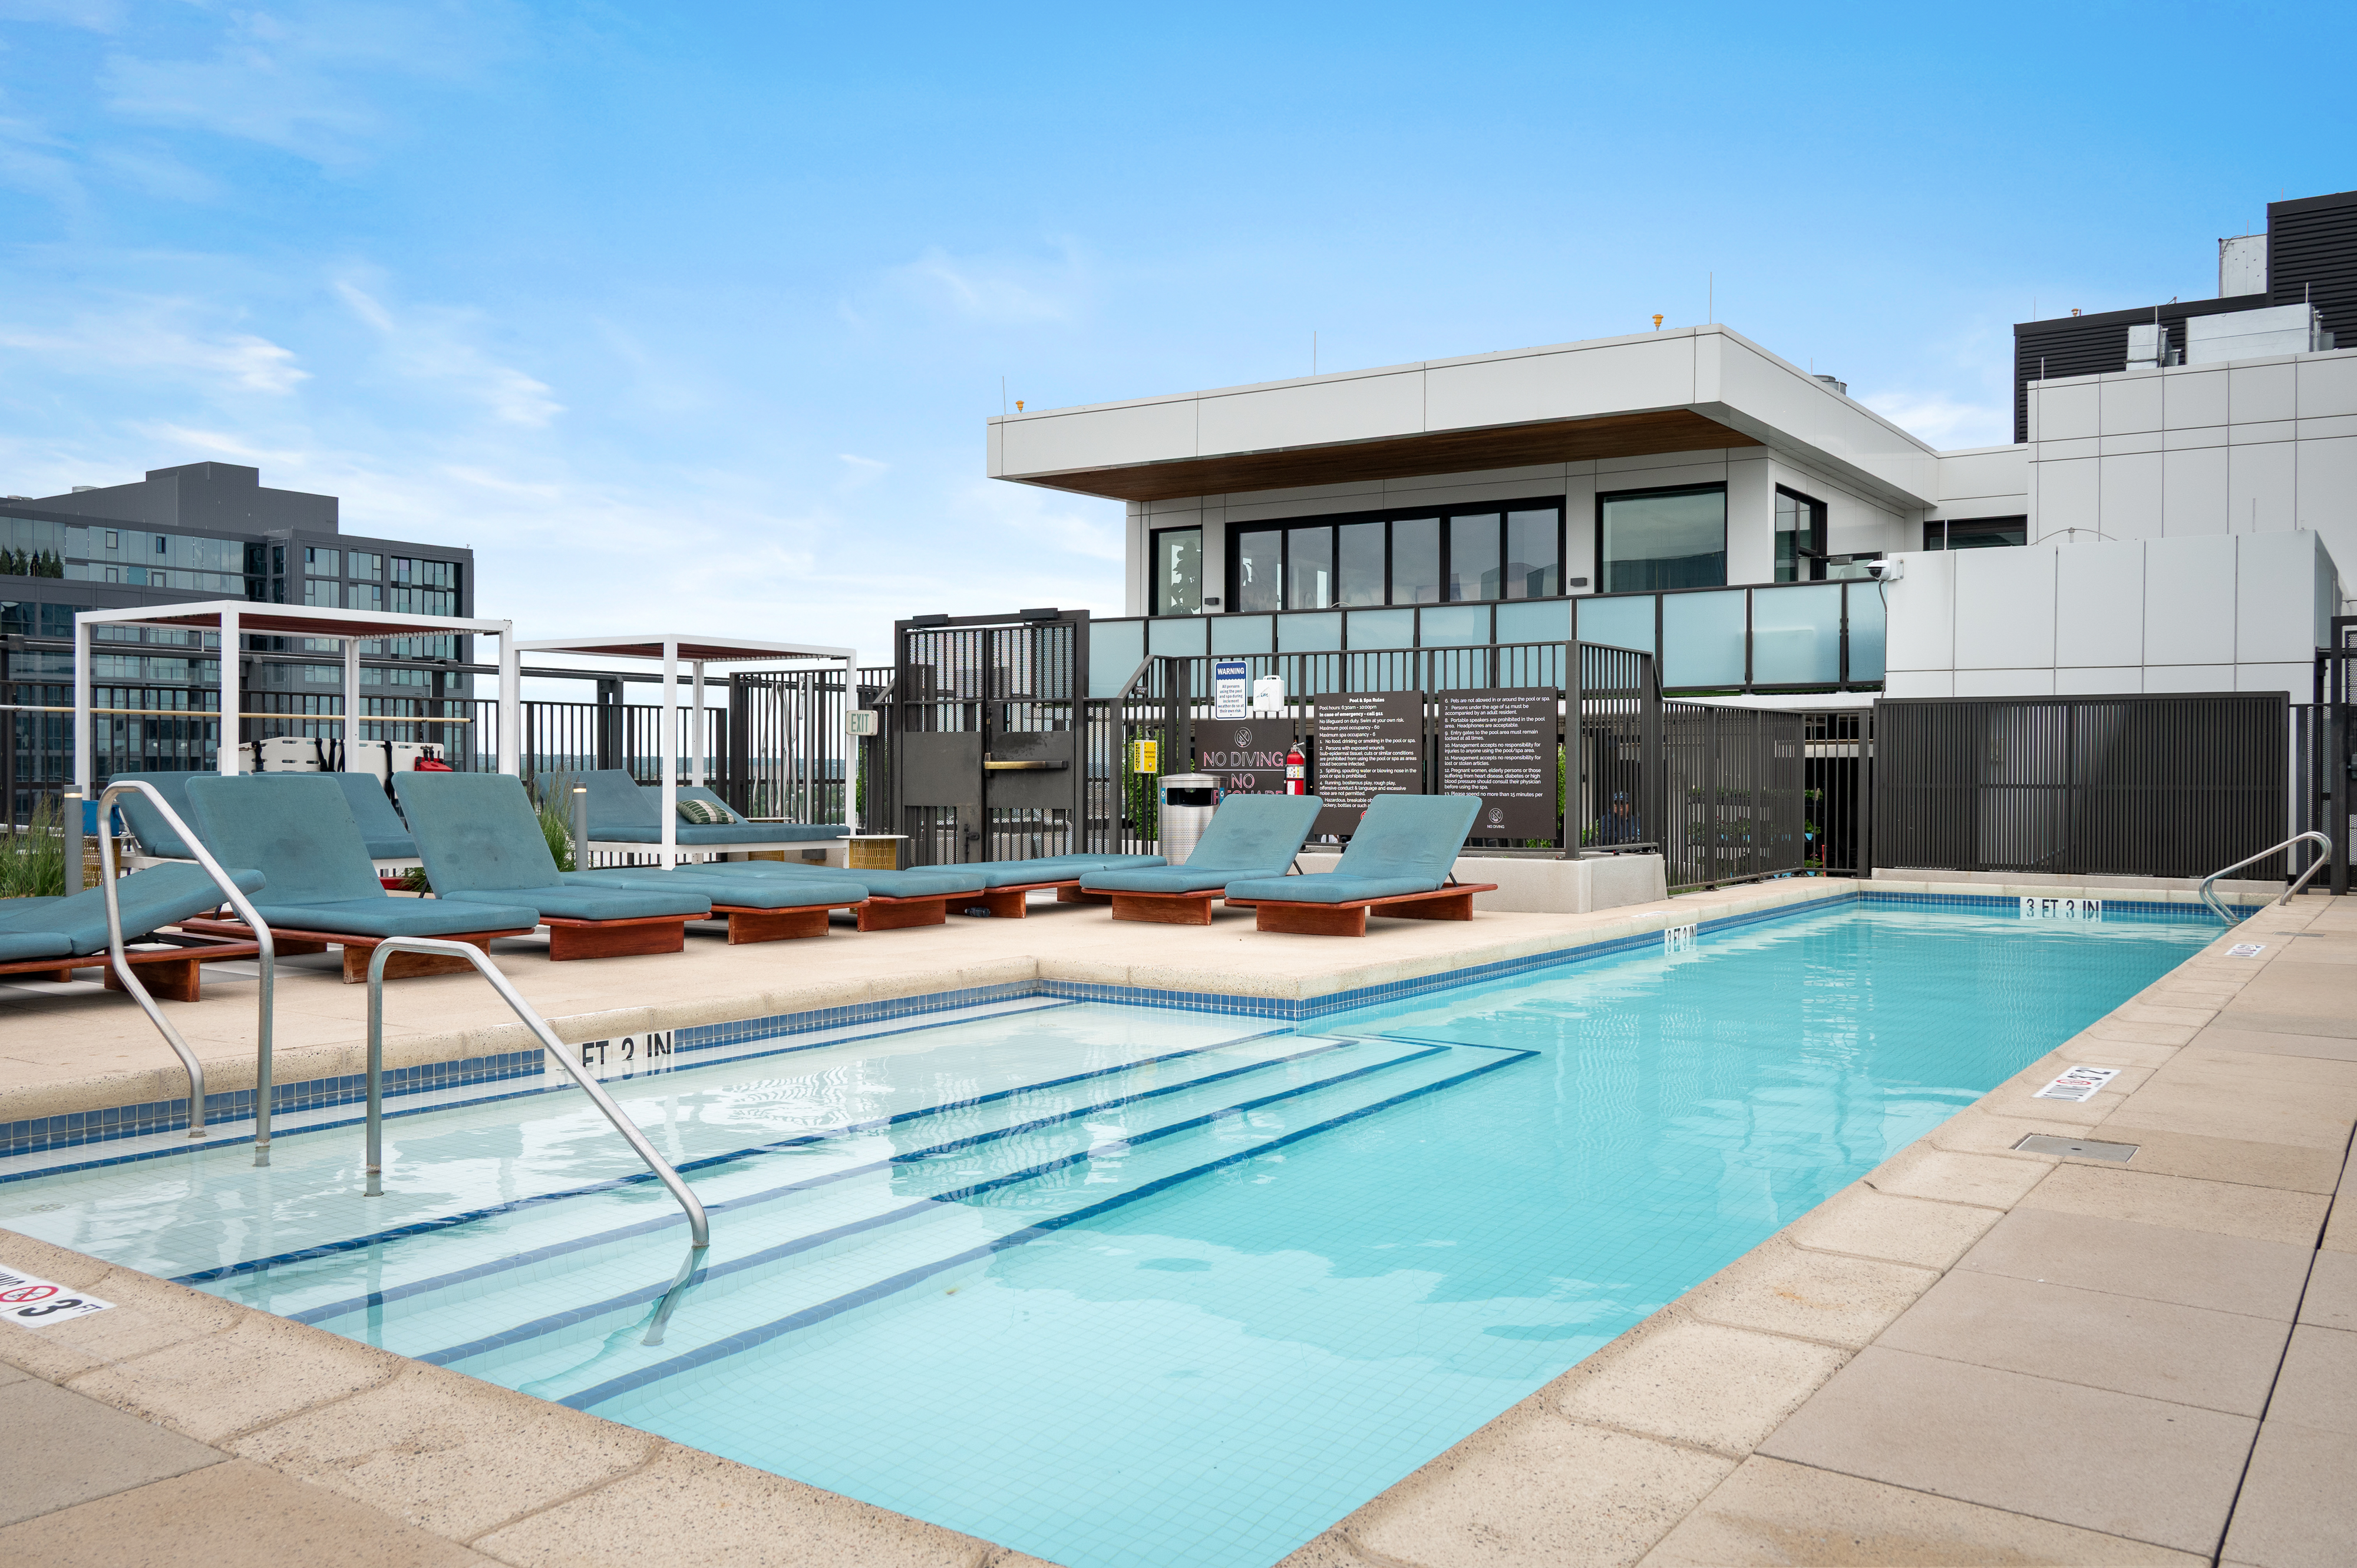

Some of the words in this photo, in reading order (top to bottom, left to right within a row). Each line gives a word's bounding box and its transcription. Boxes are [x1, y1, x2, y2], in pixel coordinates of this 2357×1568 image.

[851, 714, 869, 732] EXIT
[1203, 752, 1227, 767] NO
[1231, 751, 1283, 767] DIVING
[1232, 773, 1255, 788] NO
[2042, 899, 2058, 910] FT
[2083, 900, 2099, 911] IN
[582, 1040, 609, 1067] FT
[647, 1031, 671, 1058] IN
[18, 1299, 83, 1316] 3
